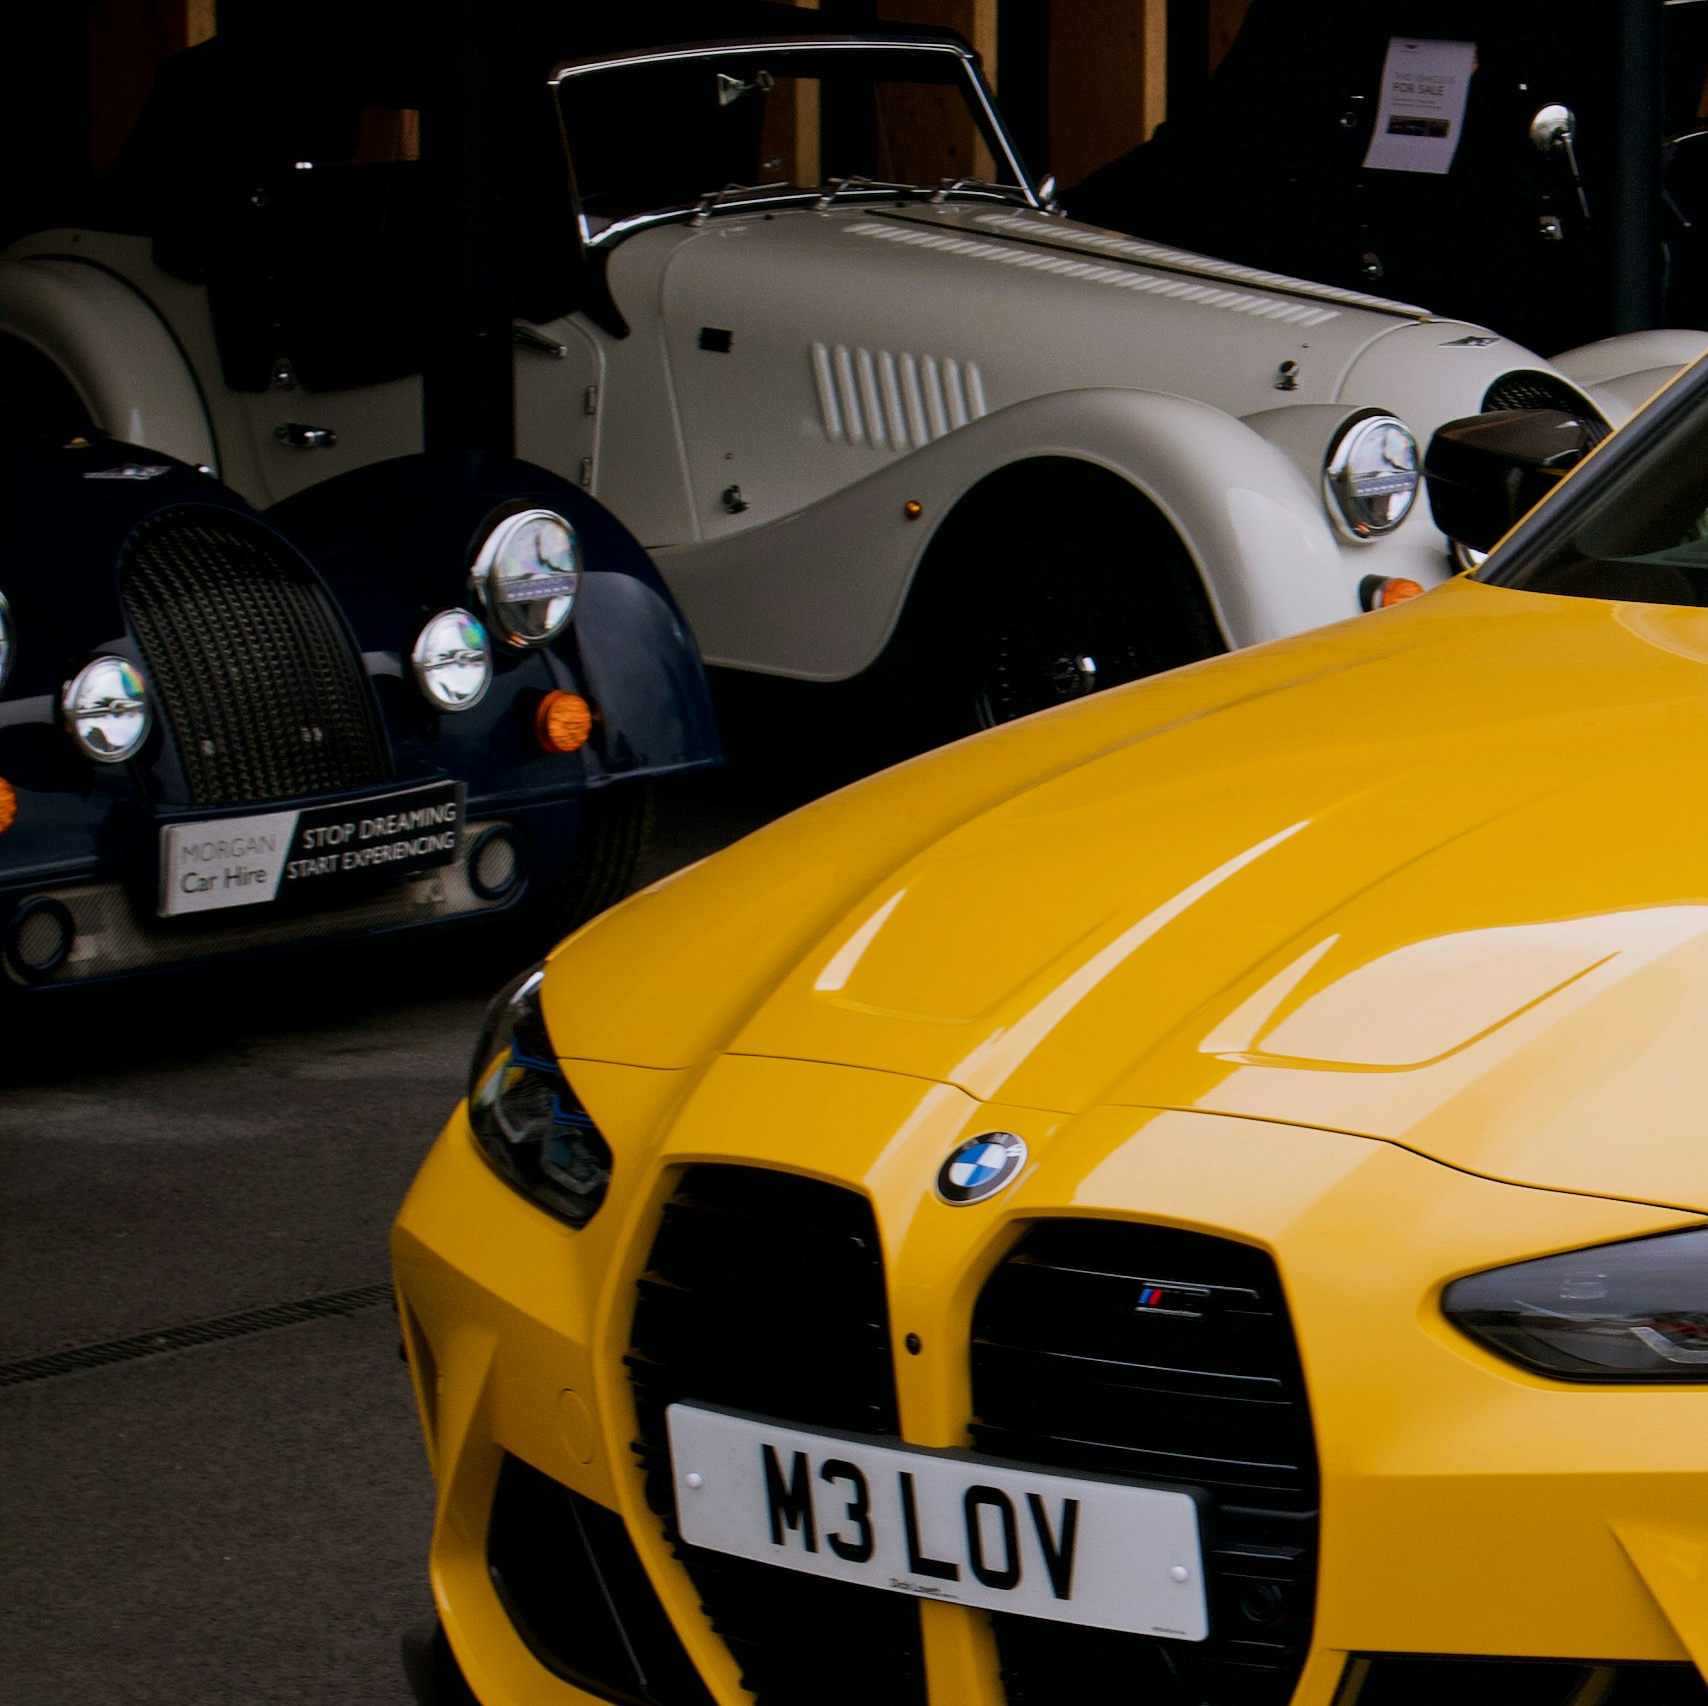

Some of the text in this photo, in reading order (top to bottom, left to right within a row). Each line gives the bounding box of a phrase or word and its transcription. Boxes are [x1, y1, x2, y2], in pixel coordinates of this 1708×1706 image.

[1418, 84, 1445, 96] SALE
[302, 802, 457, 849] STOP DREAMING
[182, 836, 276, 863] MORGAN
[286, 831, 456, 879] START EXPERIENCING
[180, 866, 268, 893] Car Hire
[761, 1444, 1080, 1601] M3 LOV
